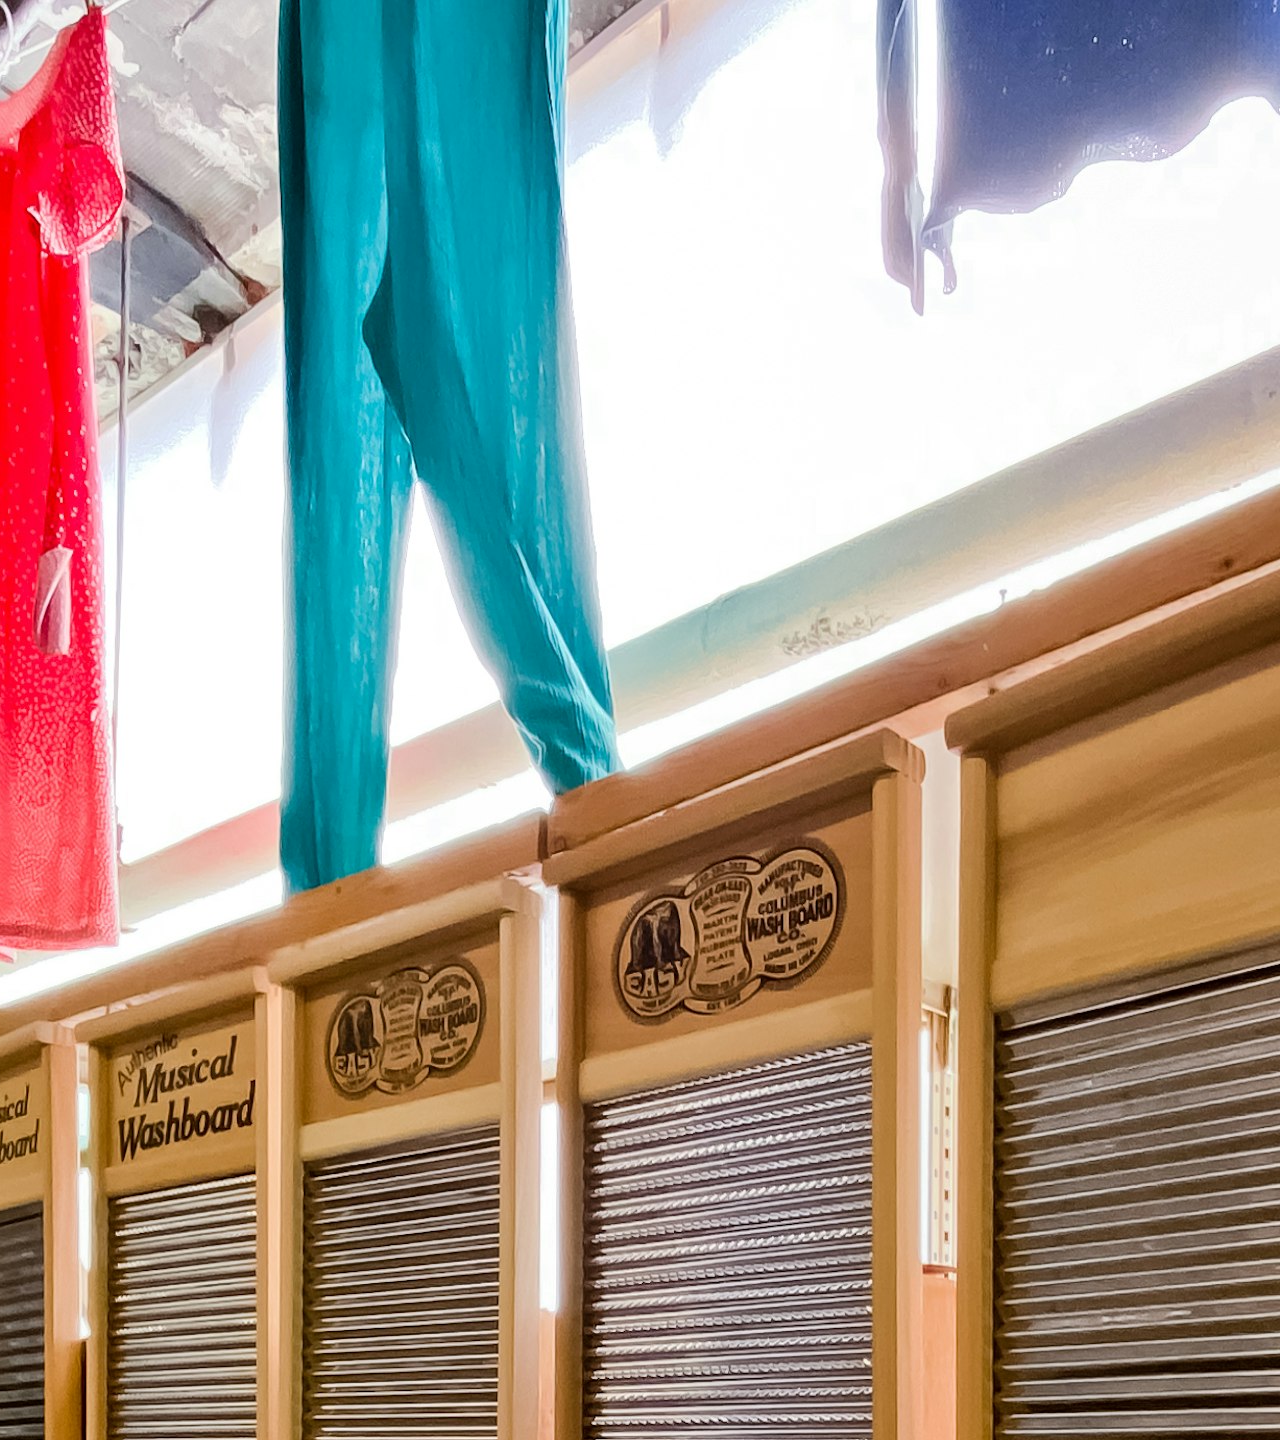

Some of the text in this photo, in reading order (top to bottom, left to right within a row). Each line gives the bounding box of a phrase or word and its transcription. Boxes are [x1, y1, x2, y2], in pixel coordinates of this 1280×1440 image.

[746, 893, 833, 942] WASH BOARD
[758, 884, 823, 915] COLUMBUS
[777, 929, 806, 944] CO.
[624, 958, 687, 999] EASY
[117, 1033, 178, 1096] Authentic
[133, 1036, 237, 1108] Musical
[334, 1048, 378, 1077] EASY
[118, 1080, 256, 1162] Washboard
